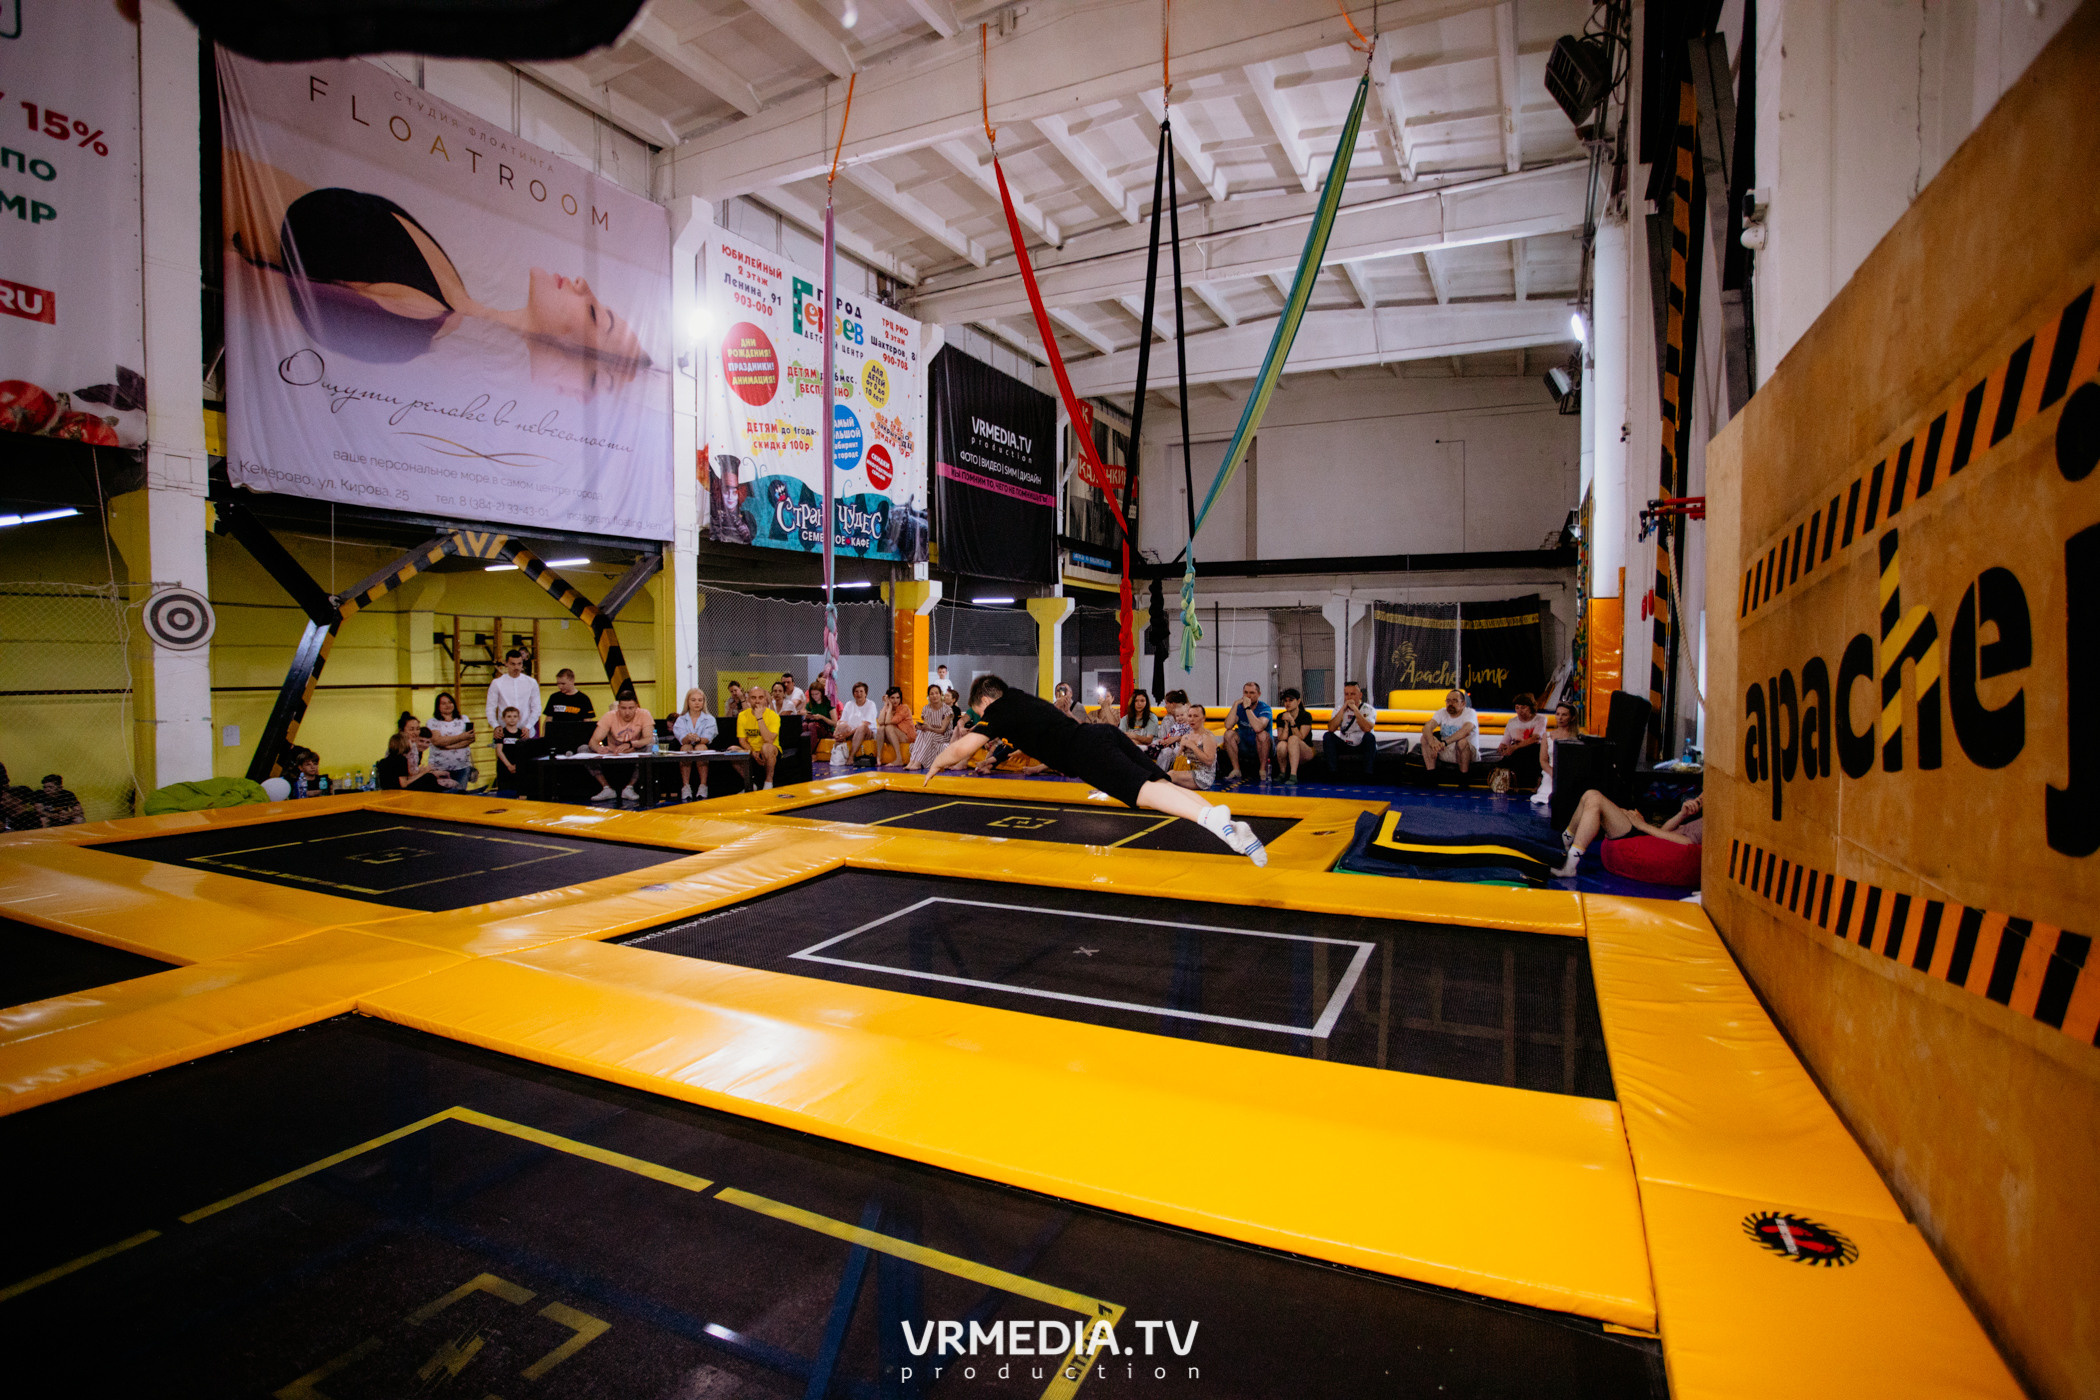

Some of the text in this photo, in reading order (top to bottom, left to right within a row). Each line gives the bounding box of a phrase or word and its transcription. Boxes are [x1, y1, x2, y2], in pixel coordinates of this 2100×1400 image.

[21, 101, 109, 157] 15%
[394, 90, 554, 173] СТУДИЯ ФЛОАТИНГА
[722, 243, 783, 280] ЮБИЛЕЙНЫЙ
[738, 265, 768, 287] 2 этаж
[734, 291, 774, 316] 903-000
[770, 292, 782, 306] 91
[817, 288, 862, 320] ГРОД
[881, 317, 894, 332] ТРЦ
[885, 330, 889, 339] 2
[787, 366, 817, 378] ДЕТЯМ
[799, 383, 850, 398] БЕСПТНО
[746, 421, 778, 434] ДЕТЯМ
[971, 415, 1032, 455] VRMEDIA.TV
[971, 436, 1033, 464] production
[333, 449, 368, 464] ваше
[370, 456, 458, 480] персональное
[460, 471, 491, 485] море
[395, 488, 410, 501] 25
[1744, 527, 2033, 822] apache
